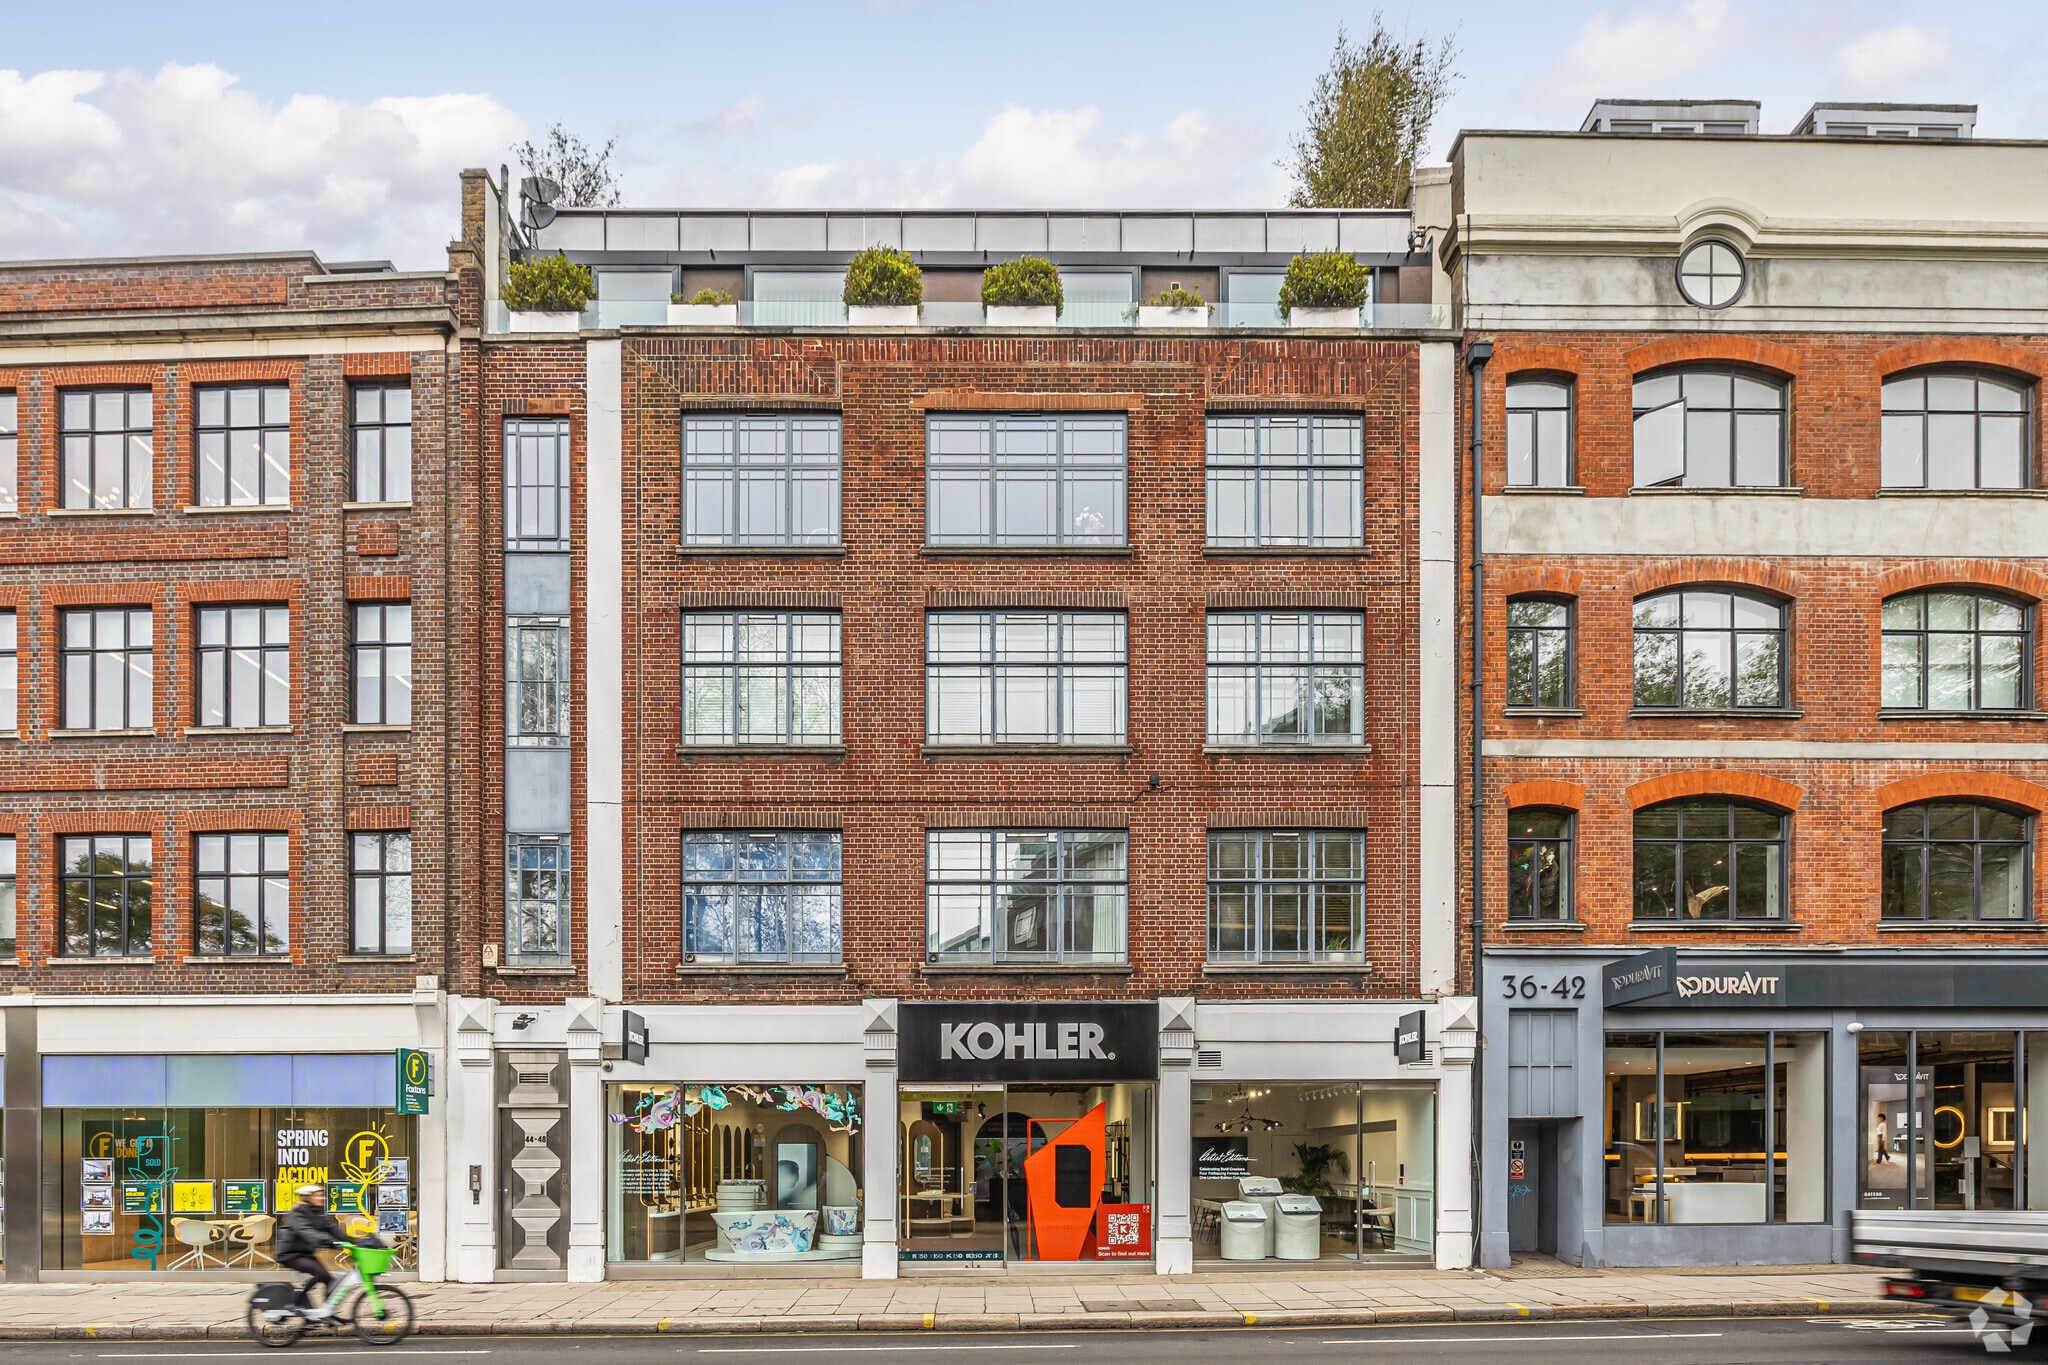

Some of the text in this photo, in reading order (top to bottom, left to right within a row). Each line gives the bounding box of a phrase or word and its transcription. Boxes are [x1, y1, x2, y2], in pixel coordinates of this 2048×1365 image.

[1625, 964, 1662, 988] DURAVIT
[1702, 971, 1779, 996] DURAVIT
[1502, 975, 1586, 999] 36-42
[405, 1084, 426, 1094] Foxtons
[277, 1130, 328, 1147] SPRING
[277, 1149, 309, 1165] INTO
[277, 1167, 328, 1184] ACTION
